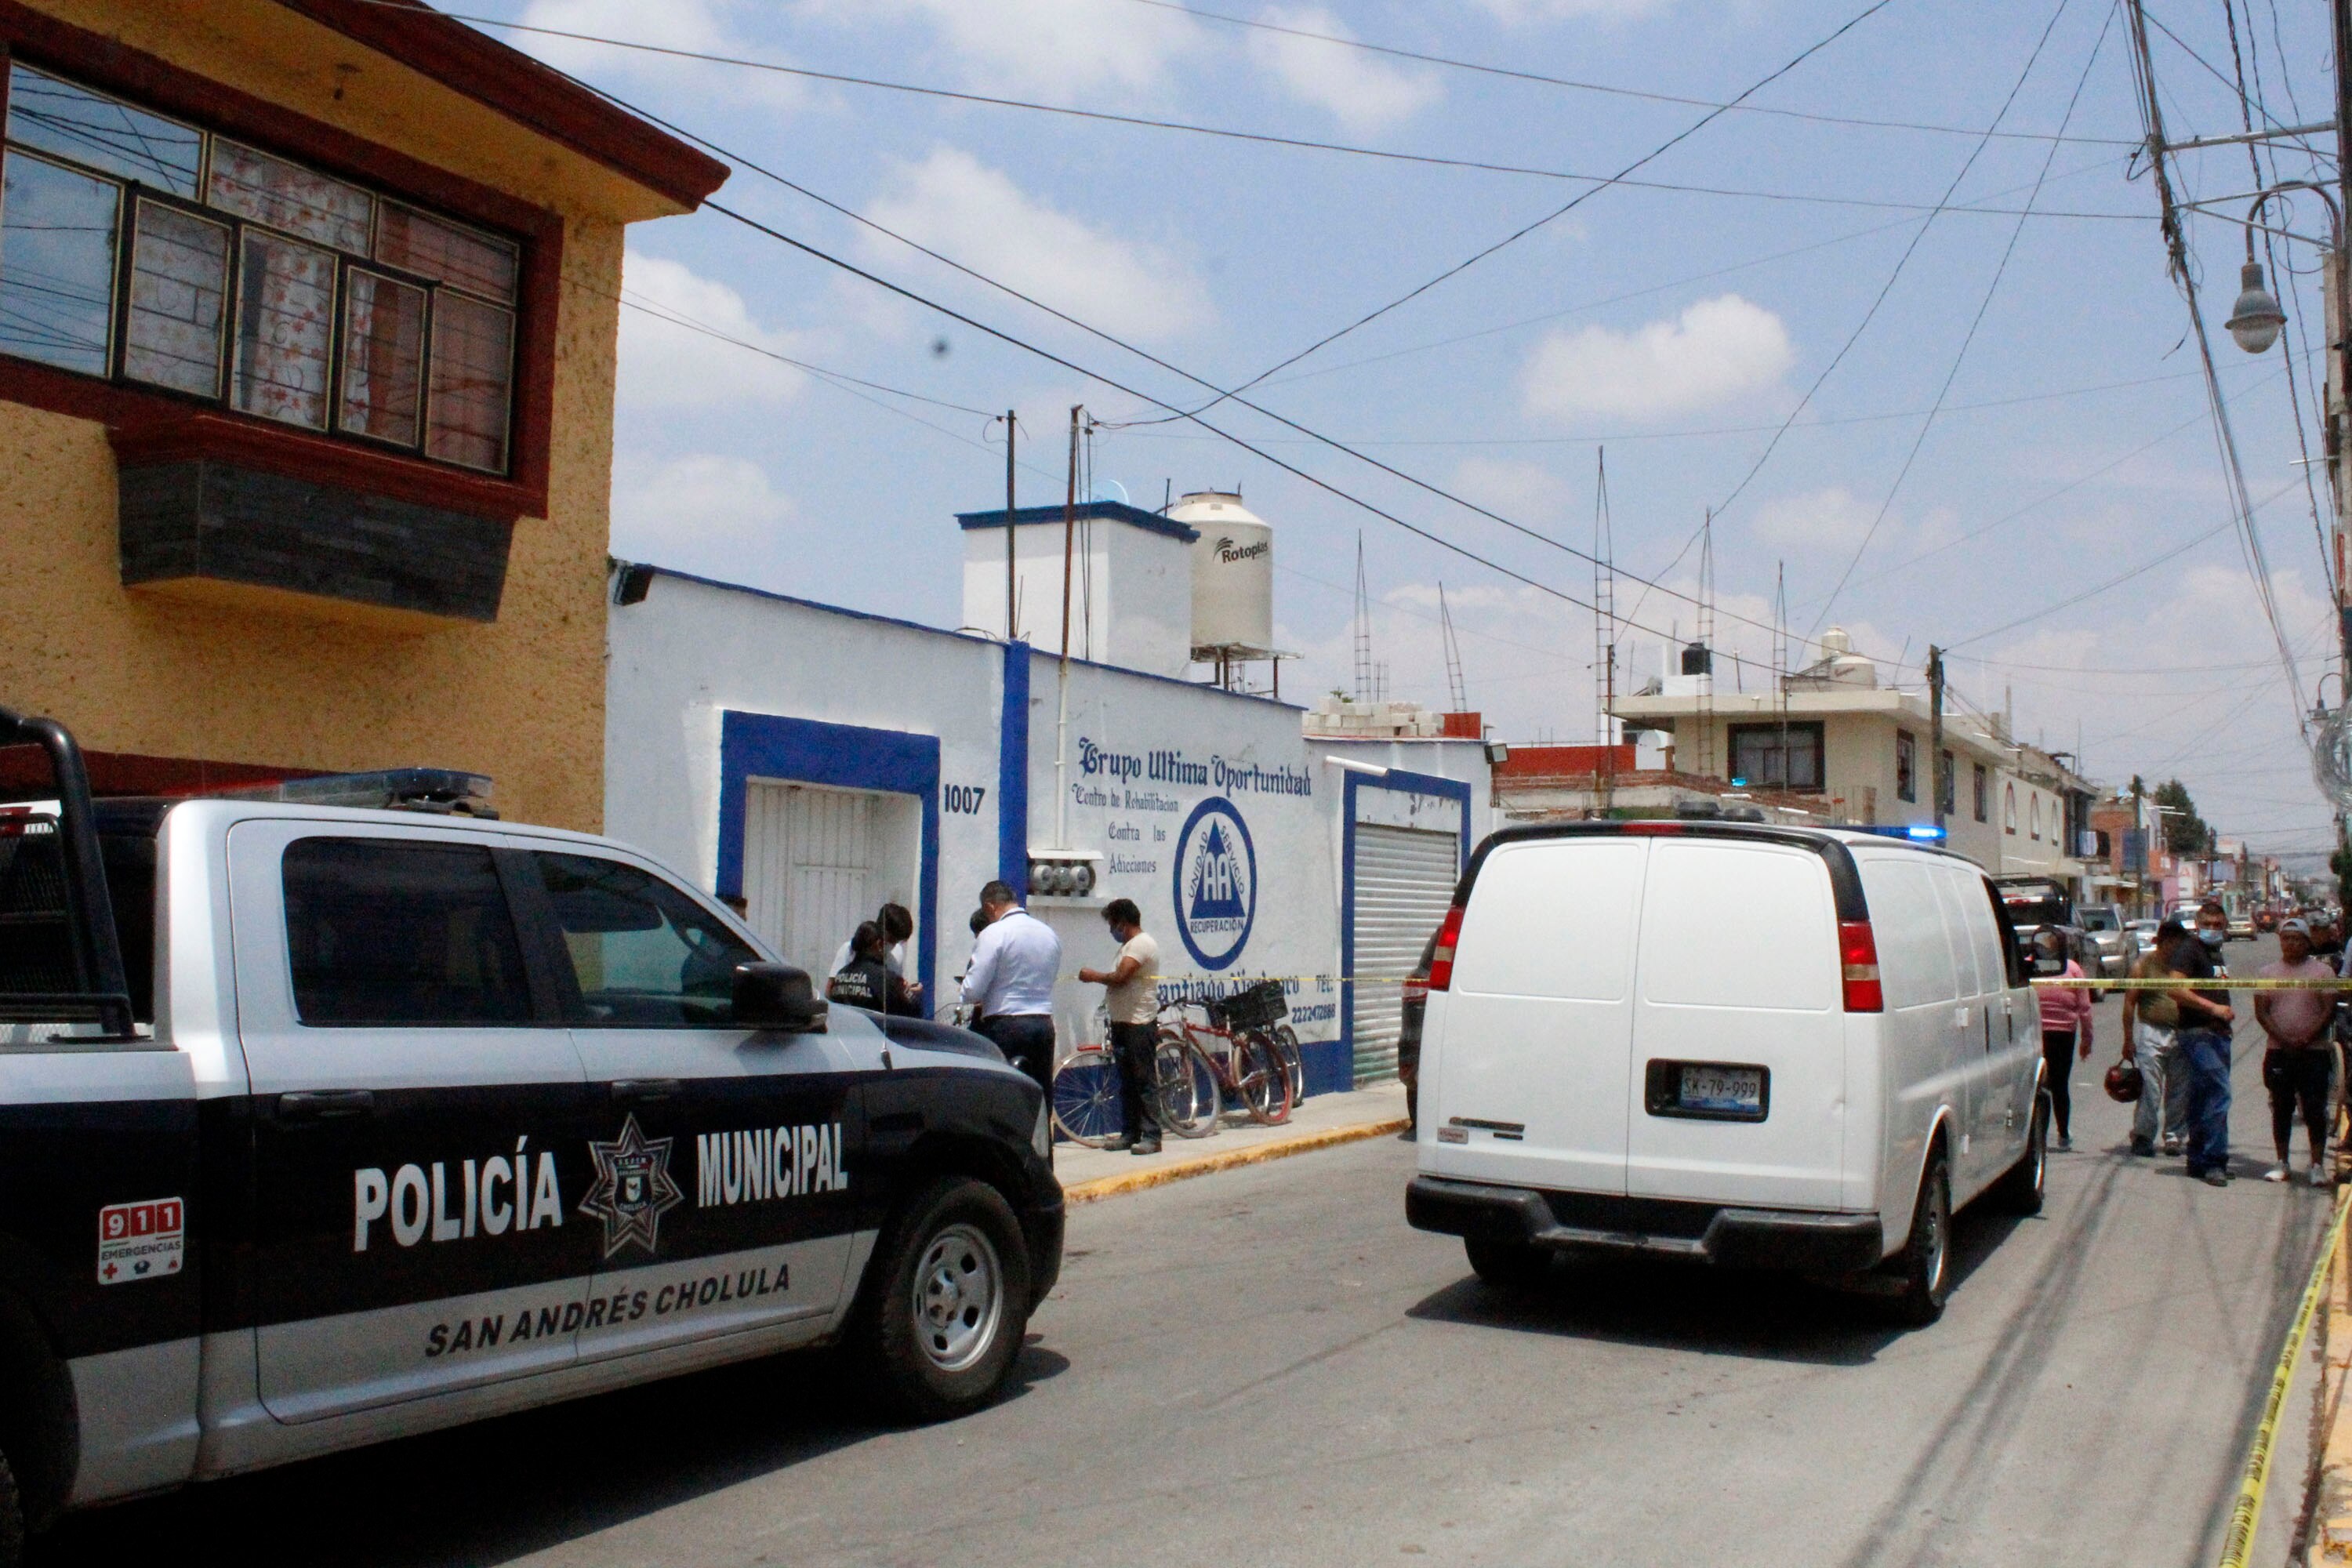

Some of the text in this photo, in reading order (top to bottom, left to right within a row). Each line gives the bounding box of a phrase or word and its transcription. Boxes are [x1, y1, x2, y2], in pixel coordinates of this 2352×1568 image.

[1079, 736, 1312, 797] Grupo Ultima Oportunidad
[944, 783, 985, 815] 1007
[1072, 783, 1107, 807] Centro
[1110, 787, 1120, 808] de
[1108, 821, 1167, 842] Contra las
[1109, 852, 1157, 874] Adicciones
[1188, 829, 1209, 898] UNIDAD
[1203, 851, 1232, 901] AA
[1220, 825, 1245, 895] SERVICIO
[354, 1122, 849, 1252] POLICÍA MUNICIPAL
[108, 1206, 174, 1236] 911
[101, 1240, 181, 1261] EMERGENCIAS
[424, 1262, 790, 1358] SAN ANDRÉS CHOLULA
